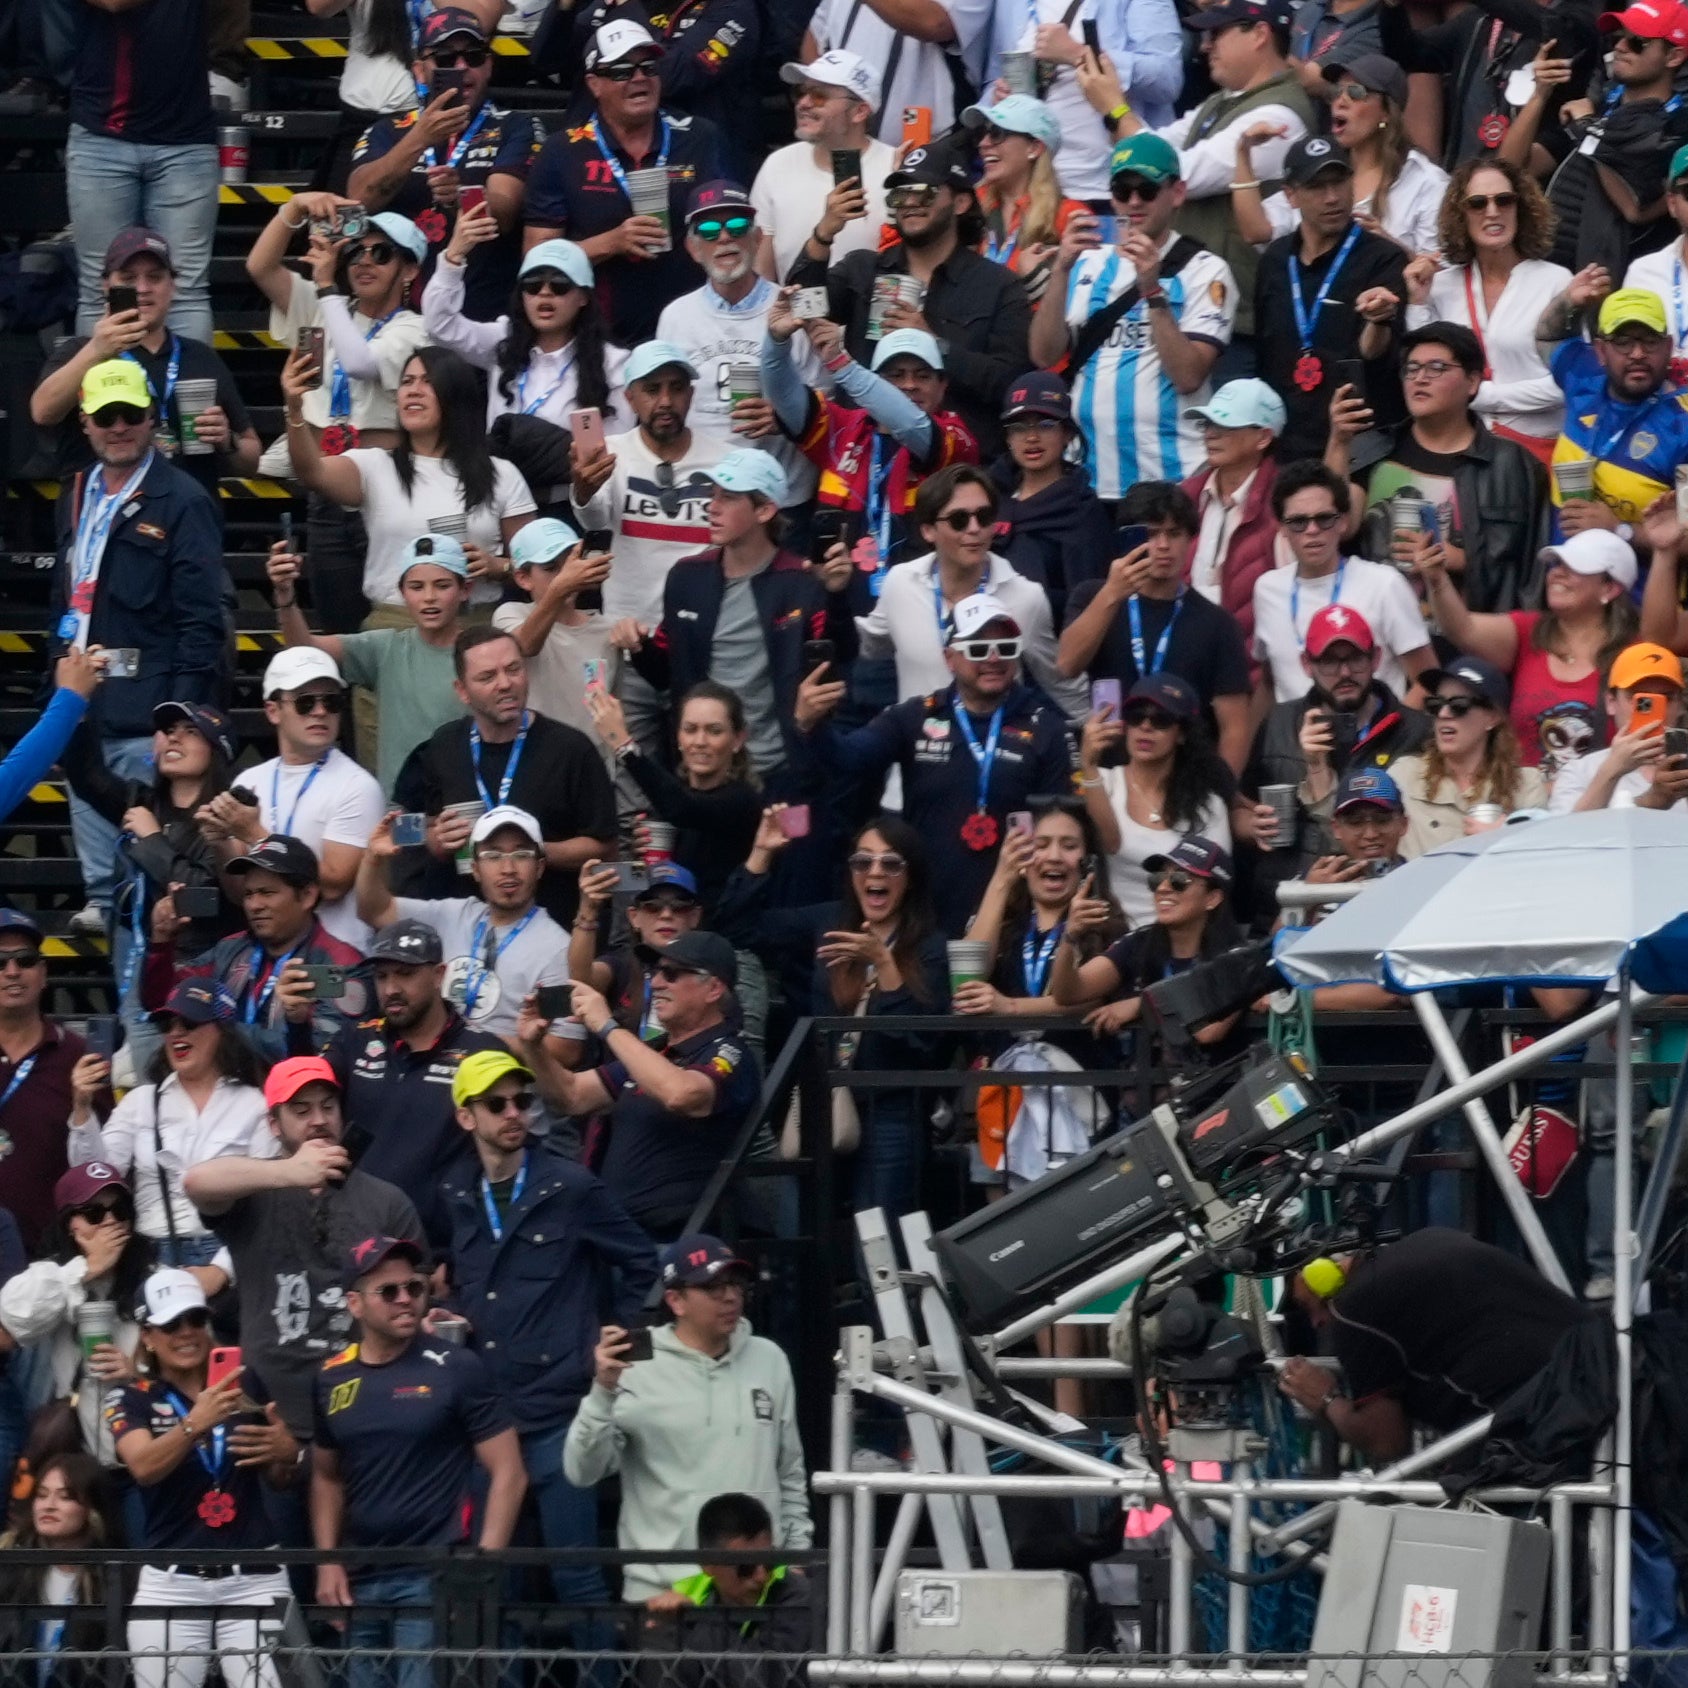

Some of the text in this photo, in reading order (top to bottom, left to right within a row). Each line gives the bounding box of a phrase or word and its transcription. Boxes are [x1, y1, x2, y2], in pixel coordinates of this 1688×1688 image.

[264, 116, 285, 129] 12
[1508, 1114, 1550, 1176] GUESS
[989, 1240, 1025, 1262] Canon
